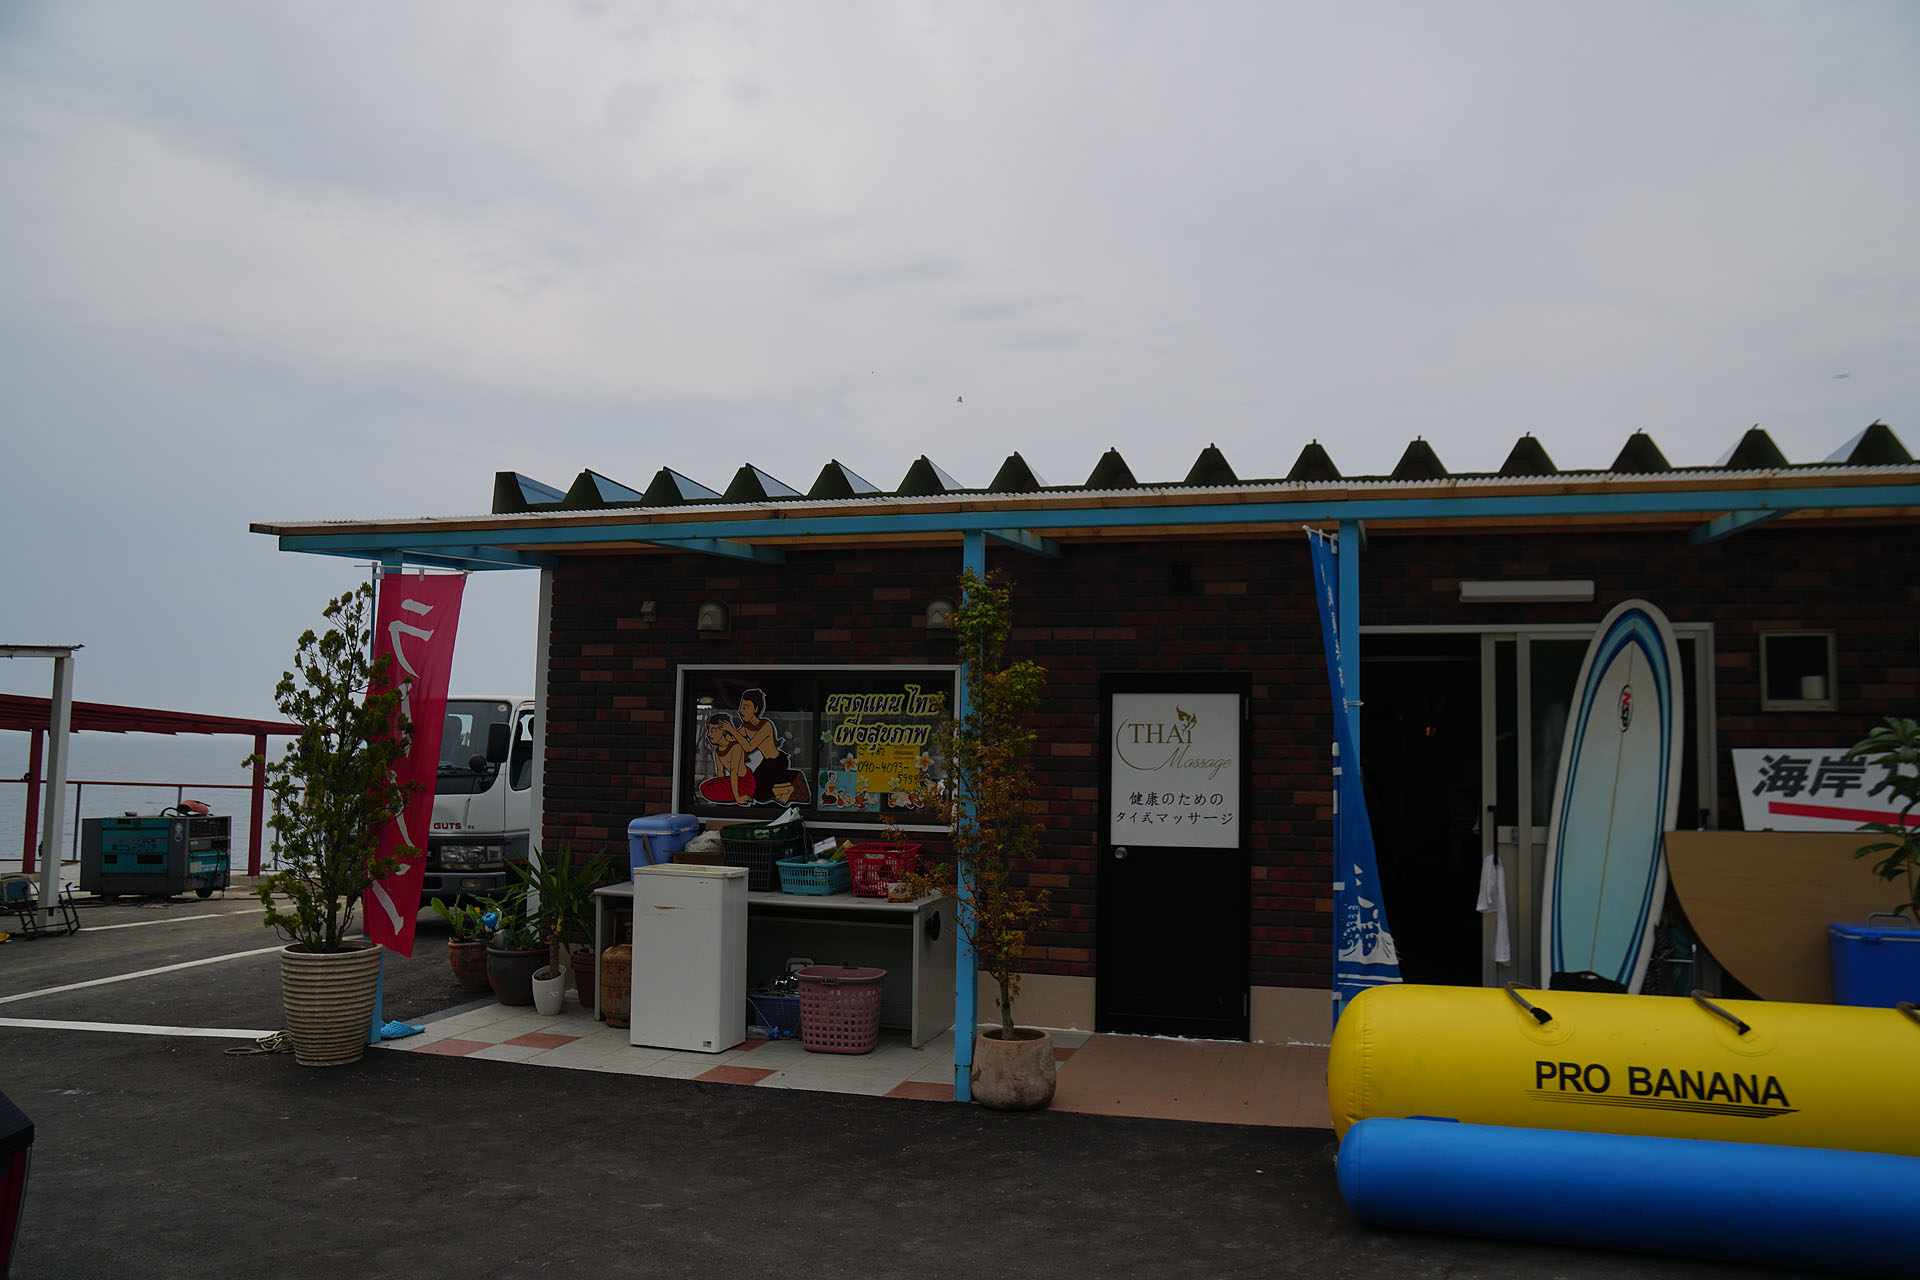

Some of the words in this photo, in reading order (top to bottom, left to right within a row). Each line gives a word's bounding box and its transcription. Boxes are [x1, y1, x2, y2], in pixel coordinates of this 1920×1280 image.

[1153, 743, 1233, 781] Massage
[1129, 791, 1224, 807] 健康のための
[433, 822, 462, 830] GUTS
[1116, 811, 1234, 825] タイ式マッサージ
[1536, 1060, 1610, 1094] PRO
[1628, 1066, 1790, 1107] BANANA
